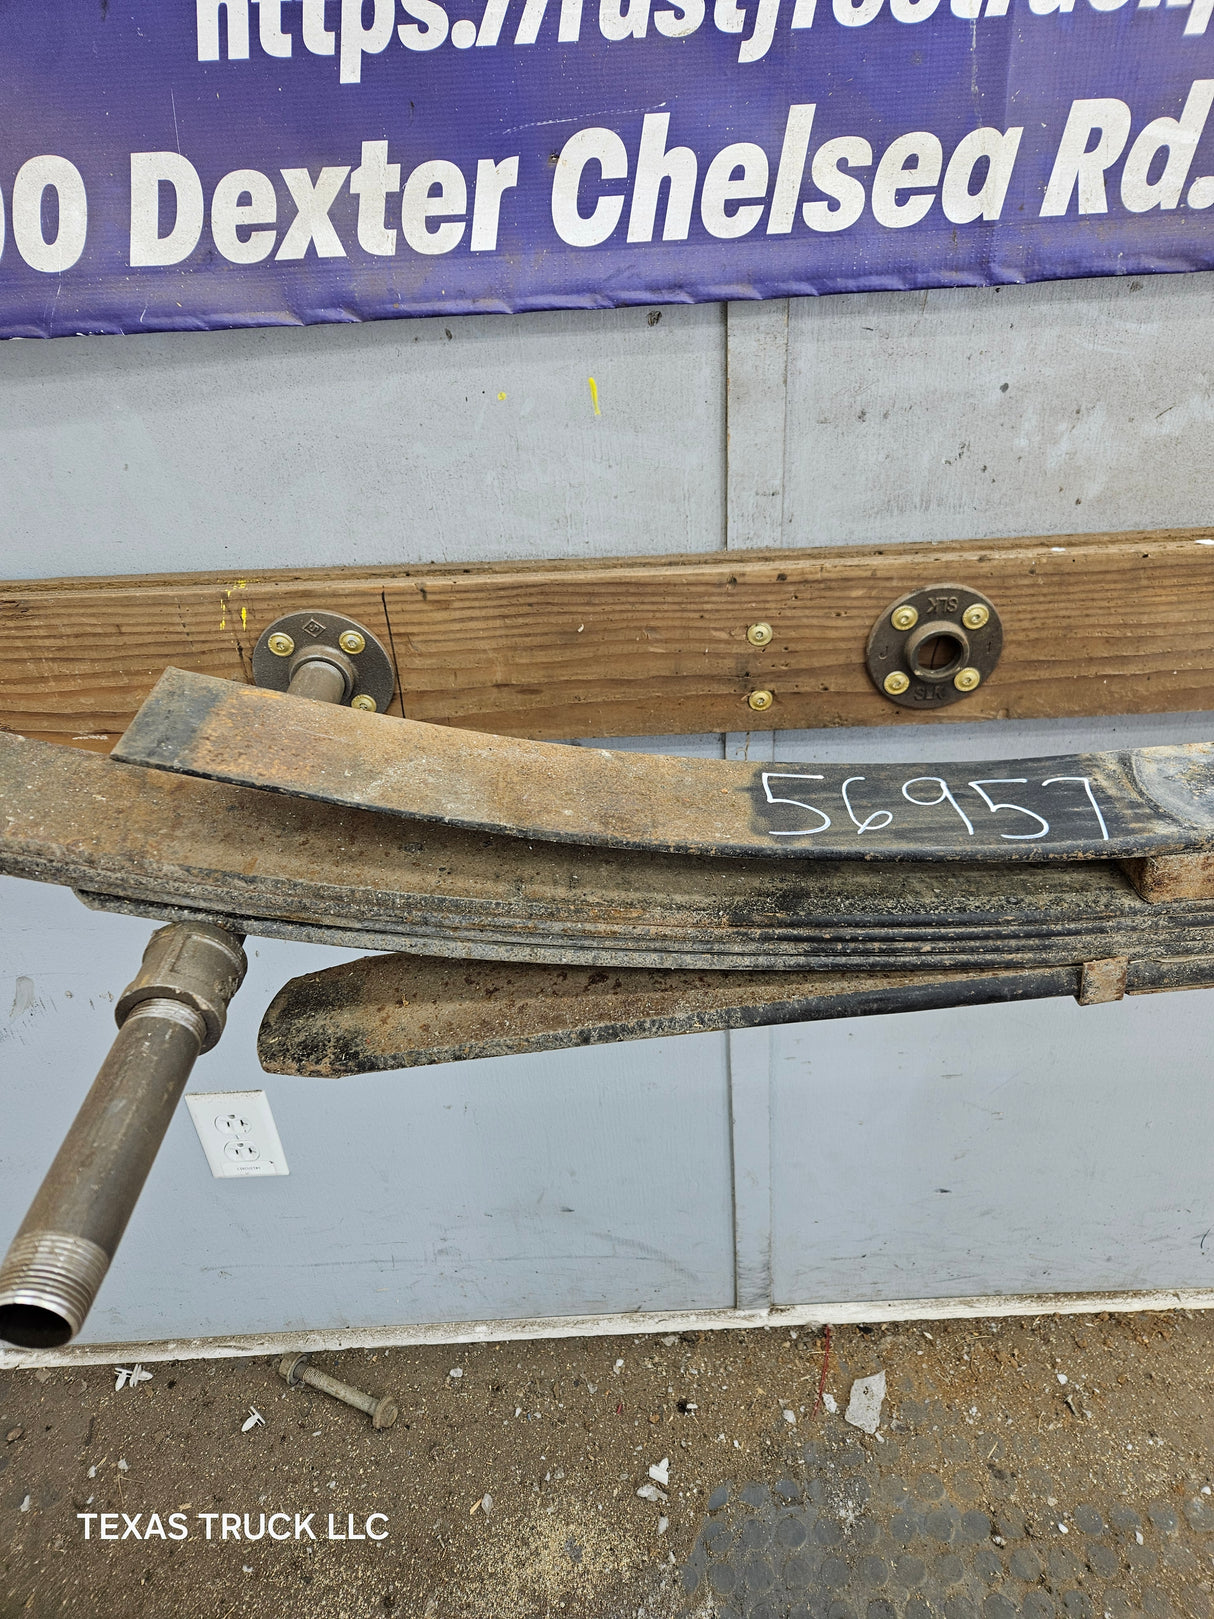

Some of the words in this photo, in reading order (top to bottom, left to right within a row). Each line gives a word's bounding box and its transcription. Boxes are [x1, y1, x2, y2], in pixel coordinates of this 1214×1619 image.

[0, 154, 87, 273] 0
[130, 140, 519, 267] Dexter
[551, 103, 1024, 248] Chelsea
[1038, 79, 1214, 217] Rd.
[761, 772, 1109, 841] 56957
